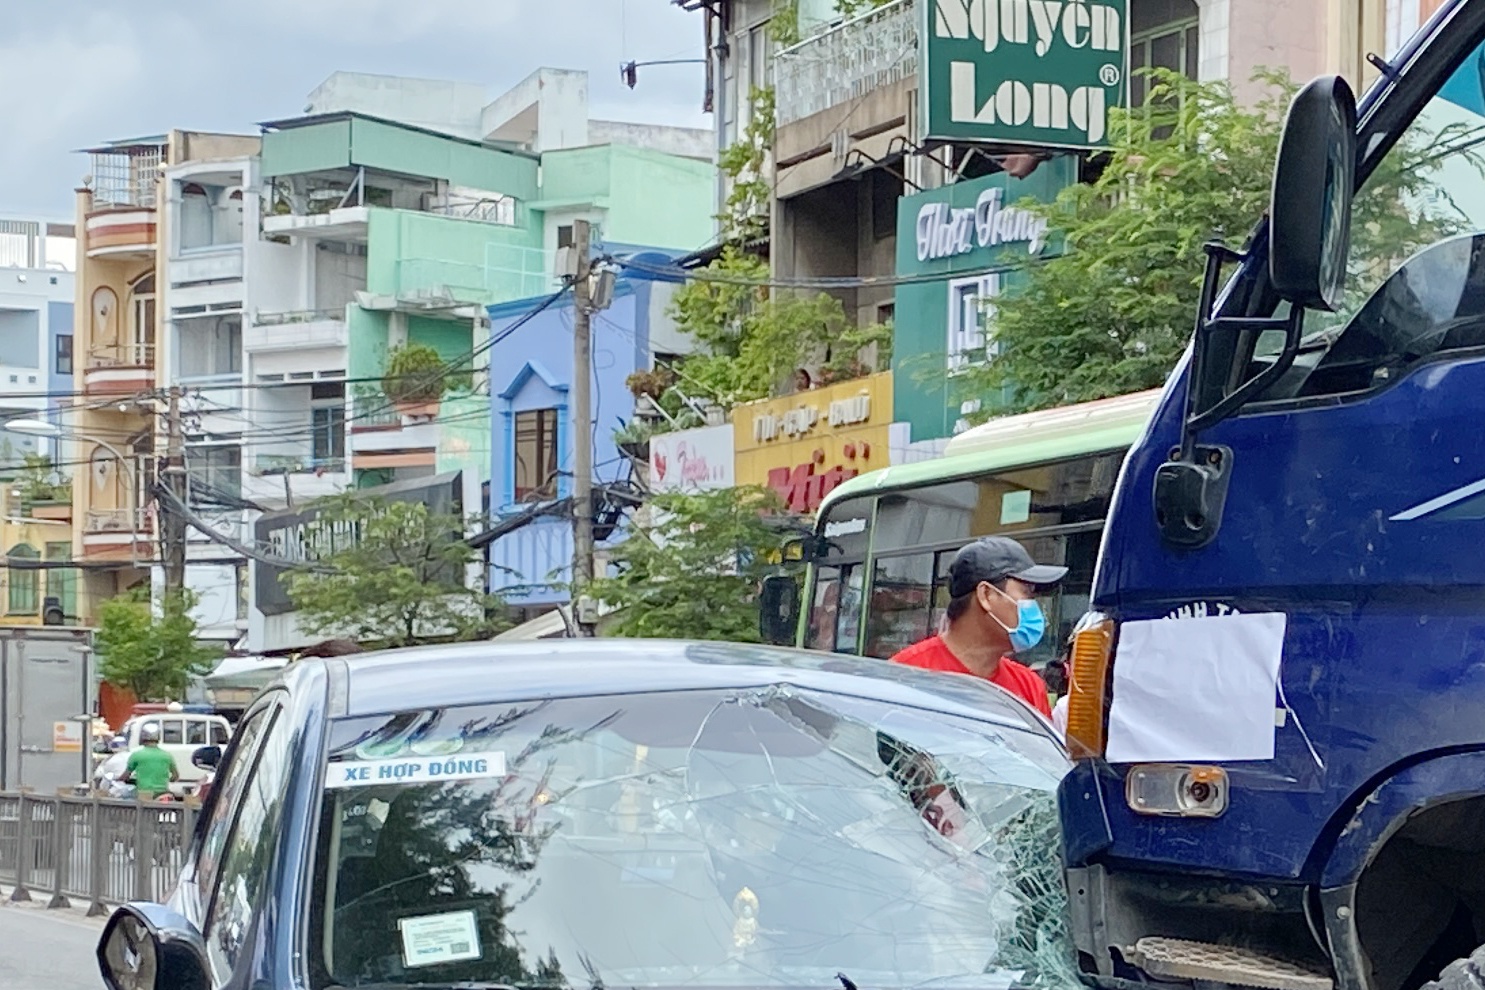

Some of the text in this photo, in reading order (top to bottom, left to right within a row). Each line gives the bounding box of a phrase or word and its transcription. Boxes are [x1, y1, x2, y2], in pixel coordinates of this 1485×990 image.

[951, 61, 1105, 143] Long
[344, 766, 371, 781] XE
[378, 762, 422, 781] HỢP
